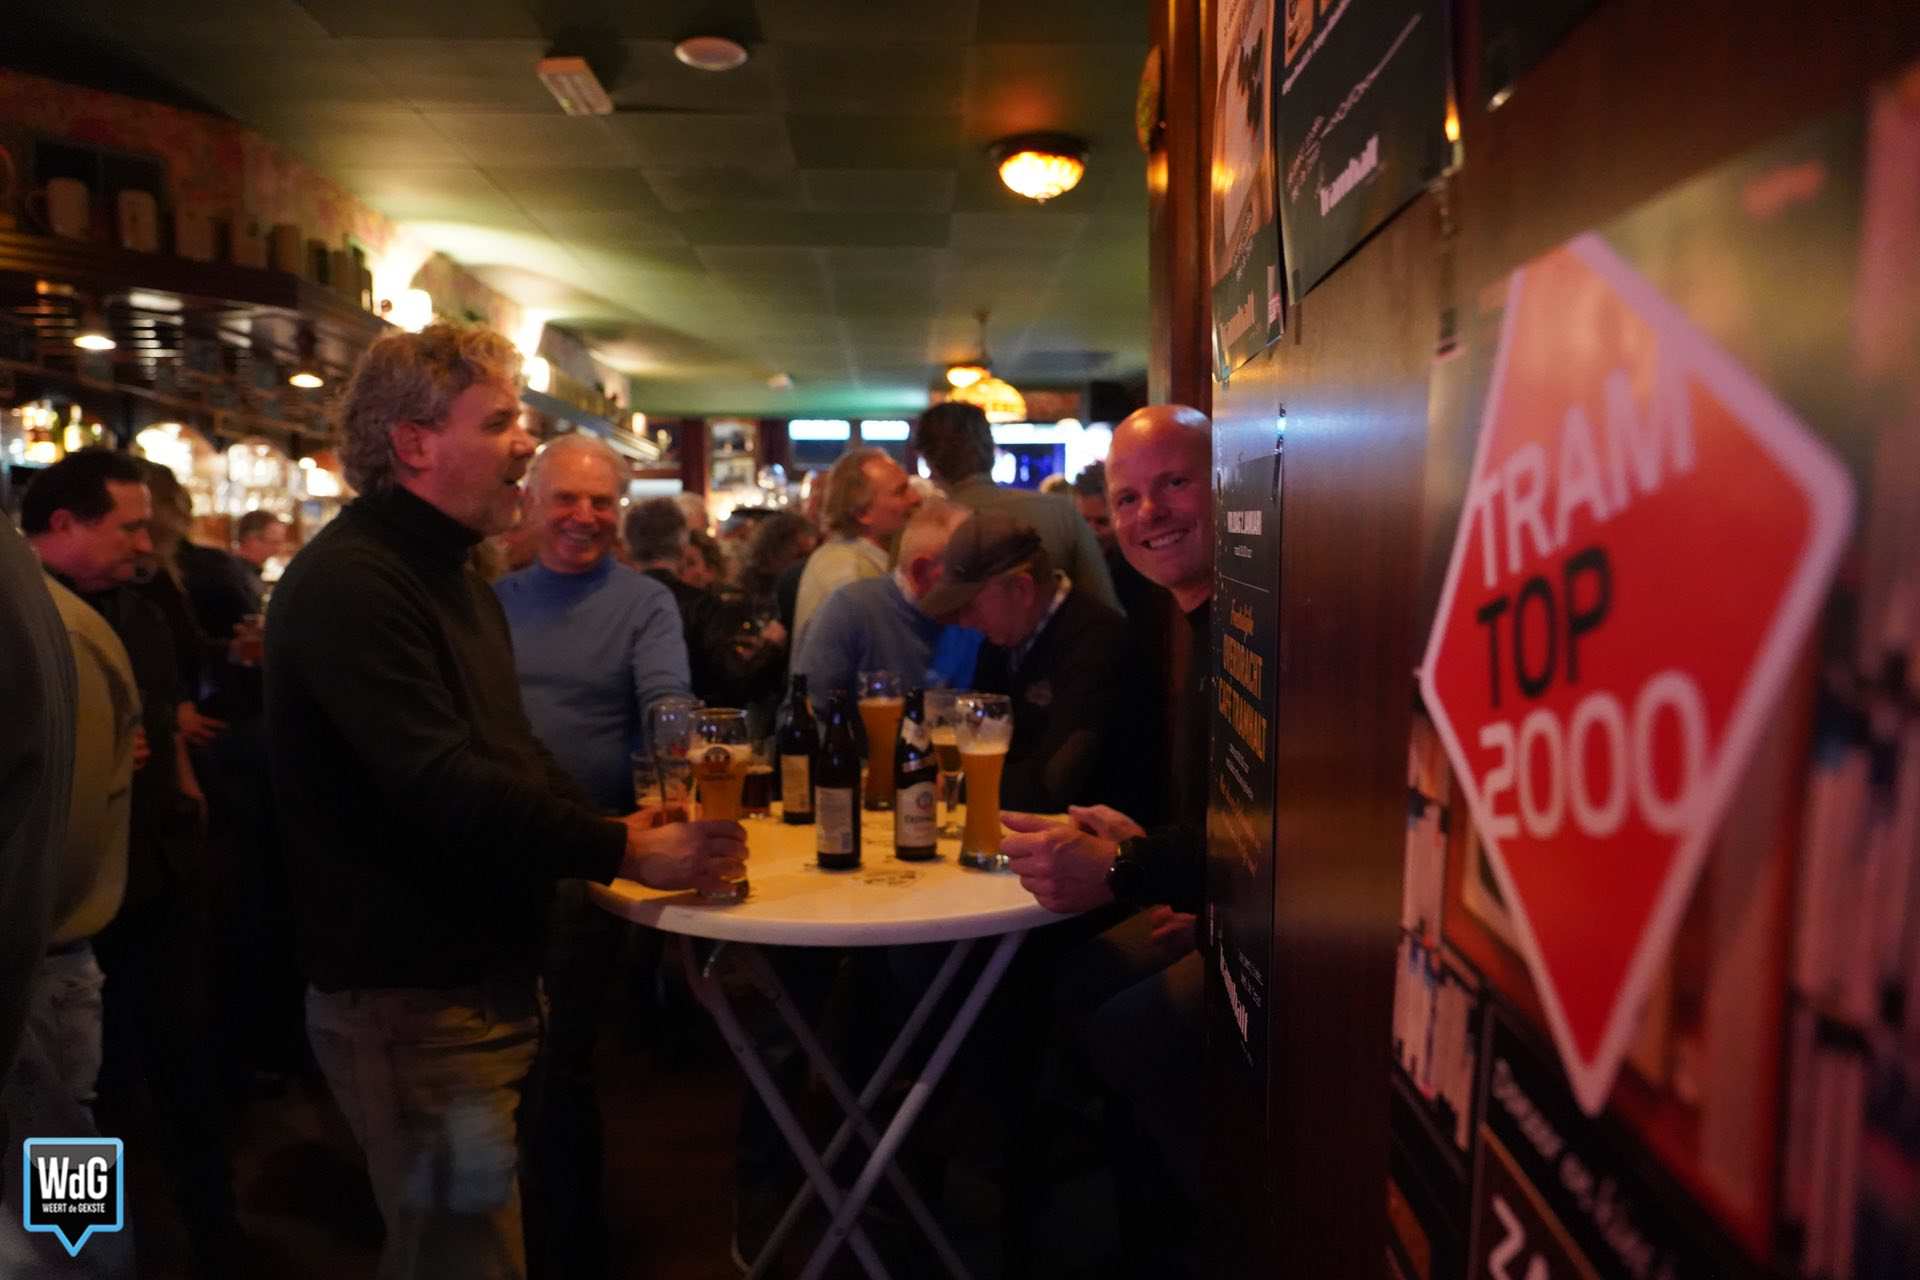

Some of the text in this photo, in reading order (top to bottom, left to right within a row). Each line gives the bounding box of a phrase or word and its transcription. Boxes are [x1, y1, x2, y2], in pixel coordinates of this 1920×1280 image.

[1470, 366, 1697, 589] TRAM
[1476, 546, 1613, 710] TOP
[1477, 668, 1711, 841] 2000
